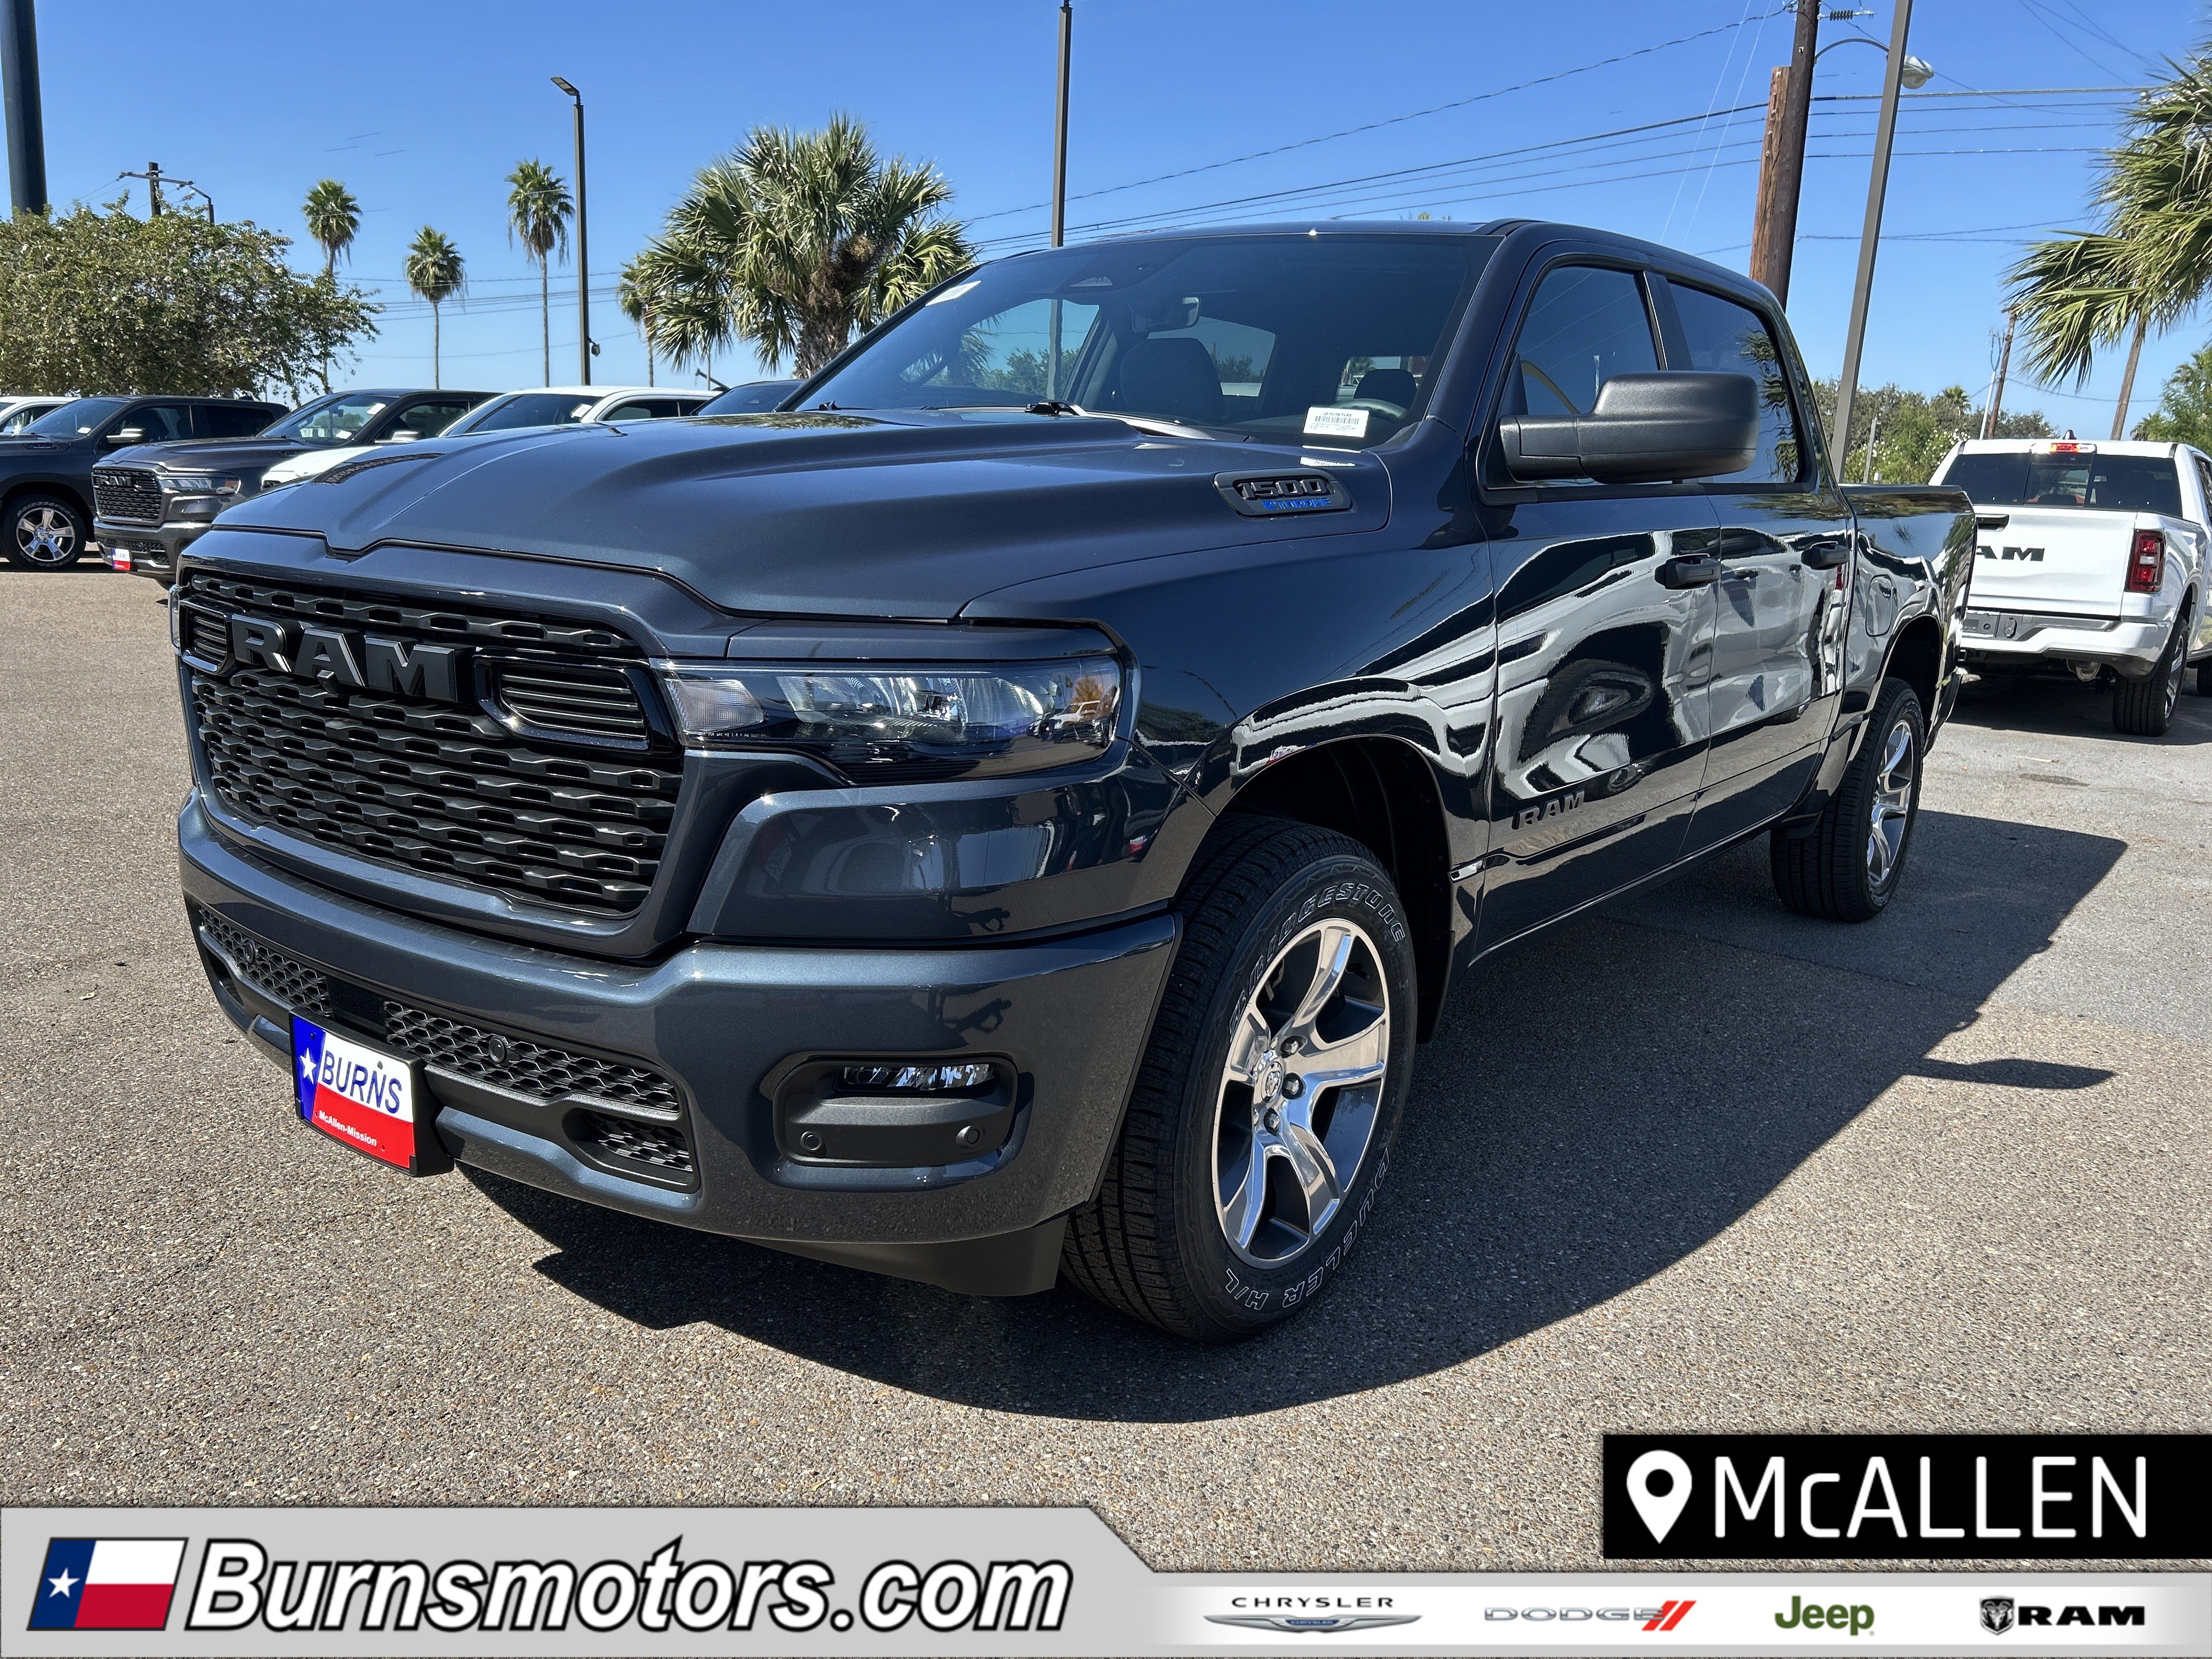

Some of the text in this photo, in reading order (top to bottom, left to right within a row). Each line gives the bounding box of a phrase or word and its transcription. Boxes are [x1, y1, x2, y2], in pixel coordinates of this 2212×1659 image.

[100, 476, 132, 487] RAM
[1237, 479, 1327, 500] 1500
[1976, 545, 2045, 562] AM
[232, 613, 458, 702] RAM
[1513, 790, 1585, 830] RAM
[1229, 883, 1406, 1043] BRIDGESTONE
[322, 1049, 402, 1114] BURNS
[319, 1110, 377, 1142] McAllen-Mission
[1226, 1147, 1390, 1311] DUELER H/L
